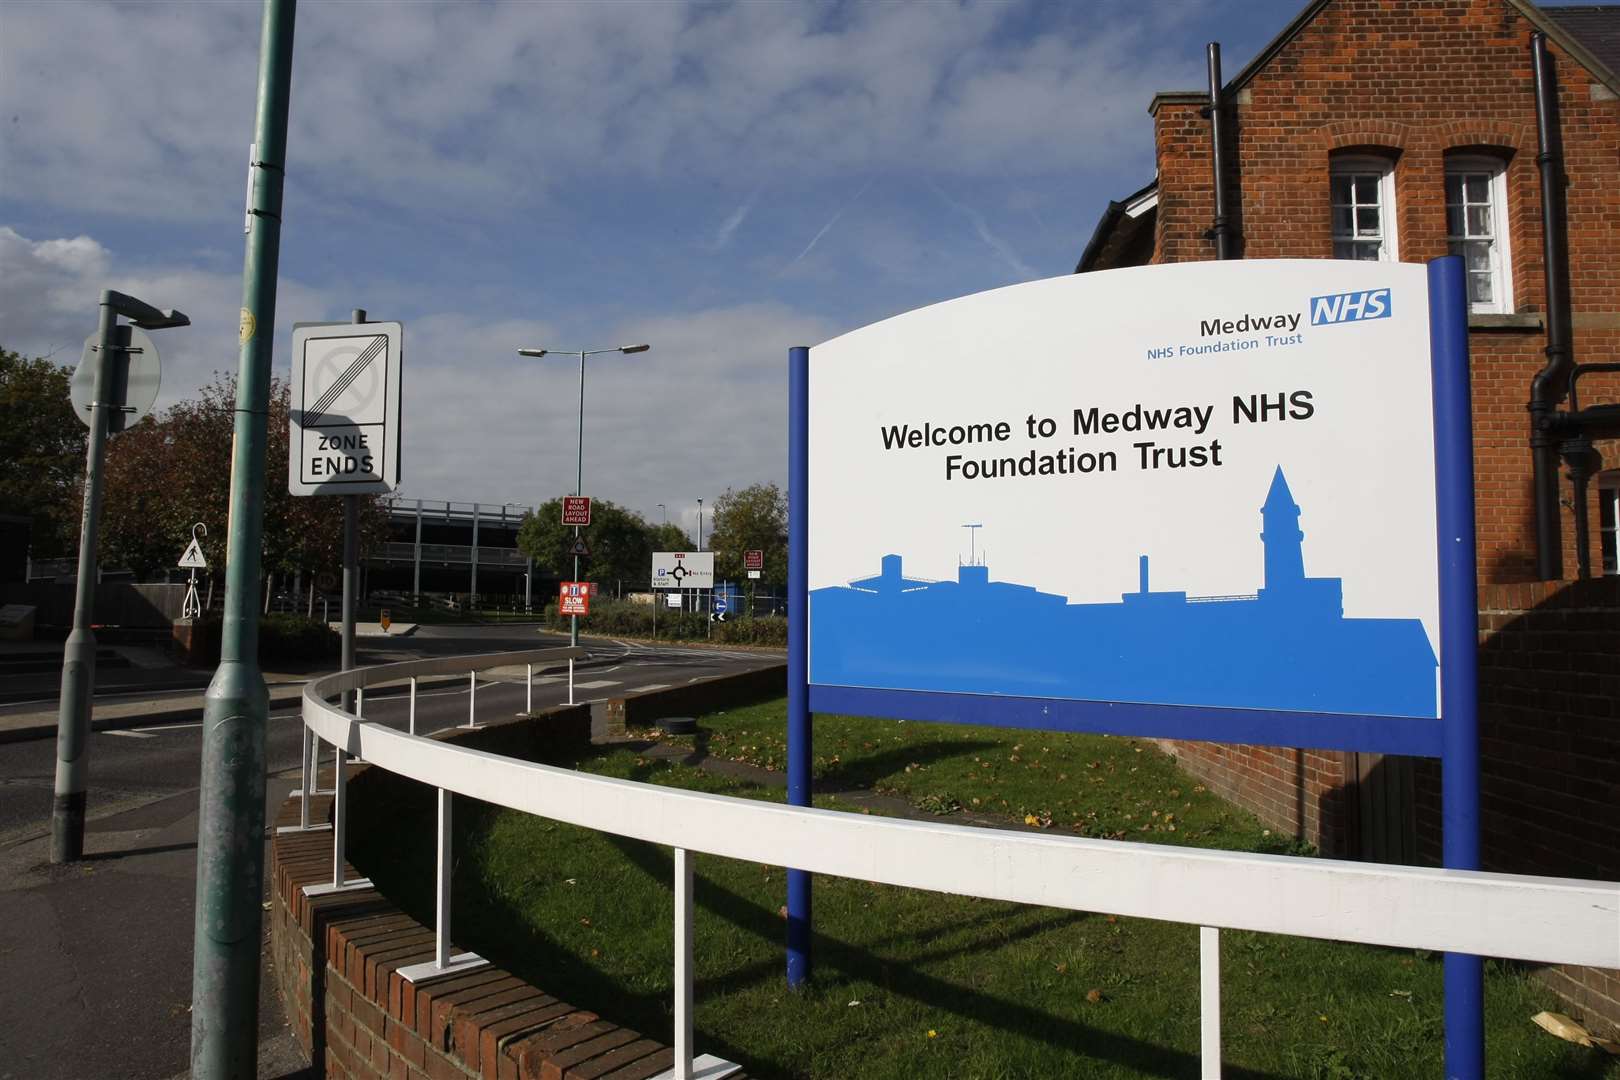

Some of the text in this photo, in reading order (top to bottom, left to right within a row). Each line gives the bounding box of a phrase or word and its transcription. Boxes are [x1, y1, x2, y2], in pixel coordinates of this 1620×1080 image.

[1200, 290, 1388, 338] Medway NHS
[1147, 333, 1304, 361] NHS Foundation Trust
[880, 390, 1315, 450] Welcome to Medway NHS
[318, 434, 369, 451] ZONE
[311, 455, 374, 476] ENDS
[946, 439, 1223, 481] Foundation Trust
[564, 596, 584, 605] SLOW
